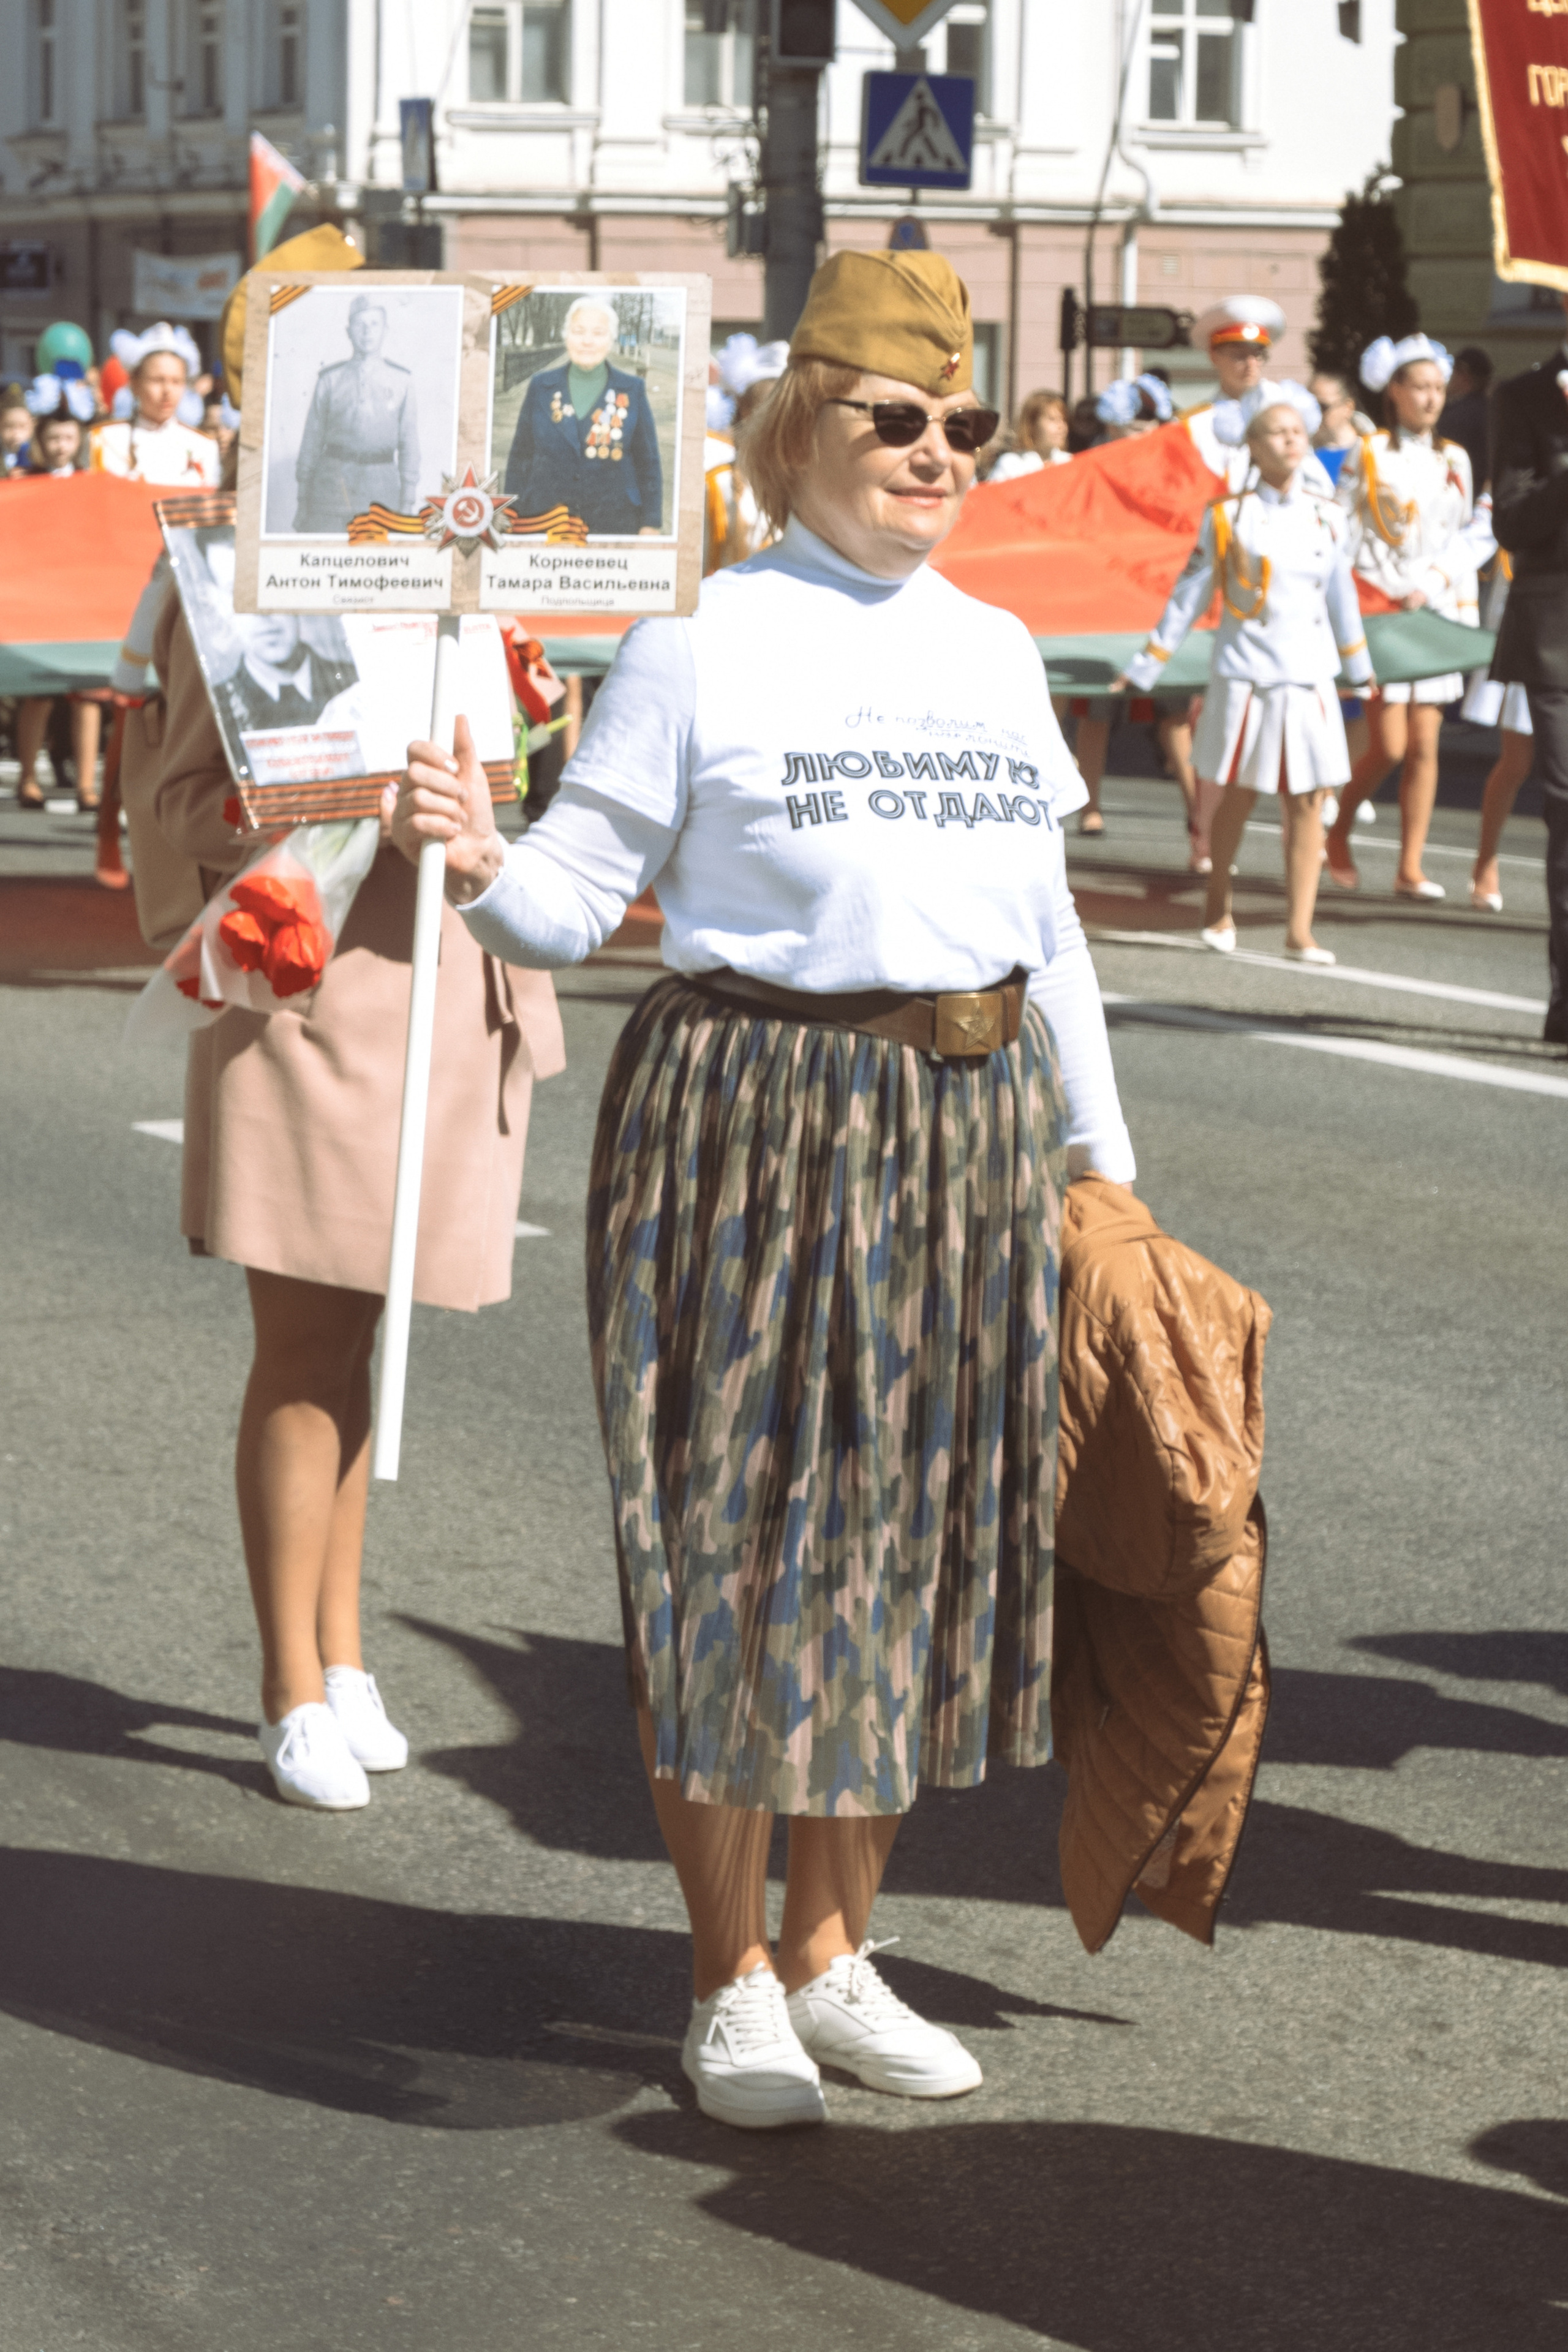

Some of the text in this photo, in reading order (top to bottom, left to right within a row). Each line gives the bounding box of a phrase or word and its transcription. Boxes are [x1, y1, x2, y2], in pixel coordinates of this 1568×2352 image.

[300, 553, 410, 568] Капцелович
[529, 554, 628, 570] Корнеевец
[266, 573, 443, 590] Антон Тимофеевич
[487, 575, 671, 592] Тамара Васильевна
[845, 706, 885, 729] Не
[785, 790, 849, 830] НЕ
